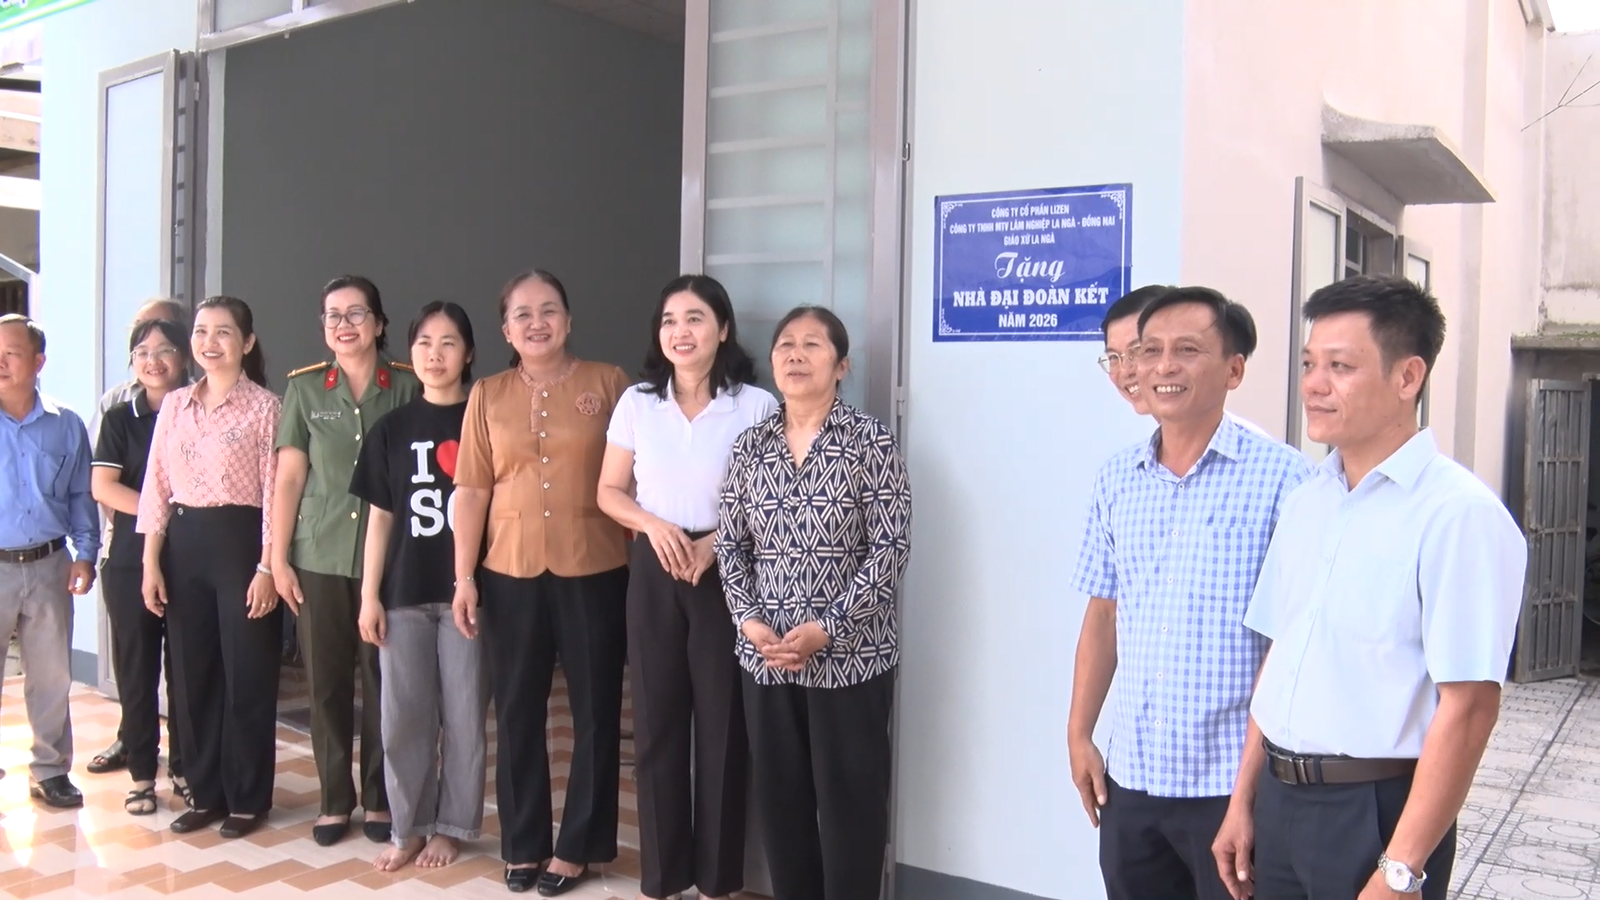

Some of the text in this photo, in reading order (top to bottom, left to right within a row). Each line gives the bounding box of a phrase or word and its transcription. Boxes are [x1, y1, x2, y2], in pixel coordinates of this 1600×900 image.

[991, 206, 1009, 218] CÔNG
[1011, 207, 1019, 217] TY
[1050, 204, 1070, 215] LIZEN
[949, 222, 967, 234] CÔNG
[968, 223, 976, 233] TY
[977, 222, 994, 232] TNHH
[995, 221, 1009, 231] MTV
[1010, 219, 1024, 231] LÂM
[1025, 217, 1050, 231] NGHIỆP
[1051, 218, 1060, 229] LA
[1061, 216, 1076, 228] NGÀ
[1102, 215, 1115, 226] NAI
[1003, 231, 1055, 246] GIÁO XỨ LA NGÀ
[994, 251, 1066, 283] Tặng
[953, 281, 1109, 310] NHÀ ĐẠI ĐOÀN KẾT
[998, 311, 1058, 328] NĂM 2026
[410, 440, 435, 484] I
